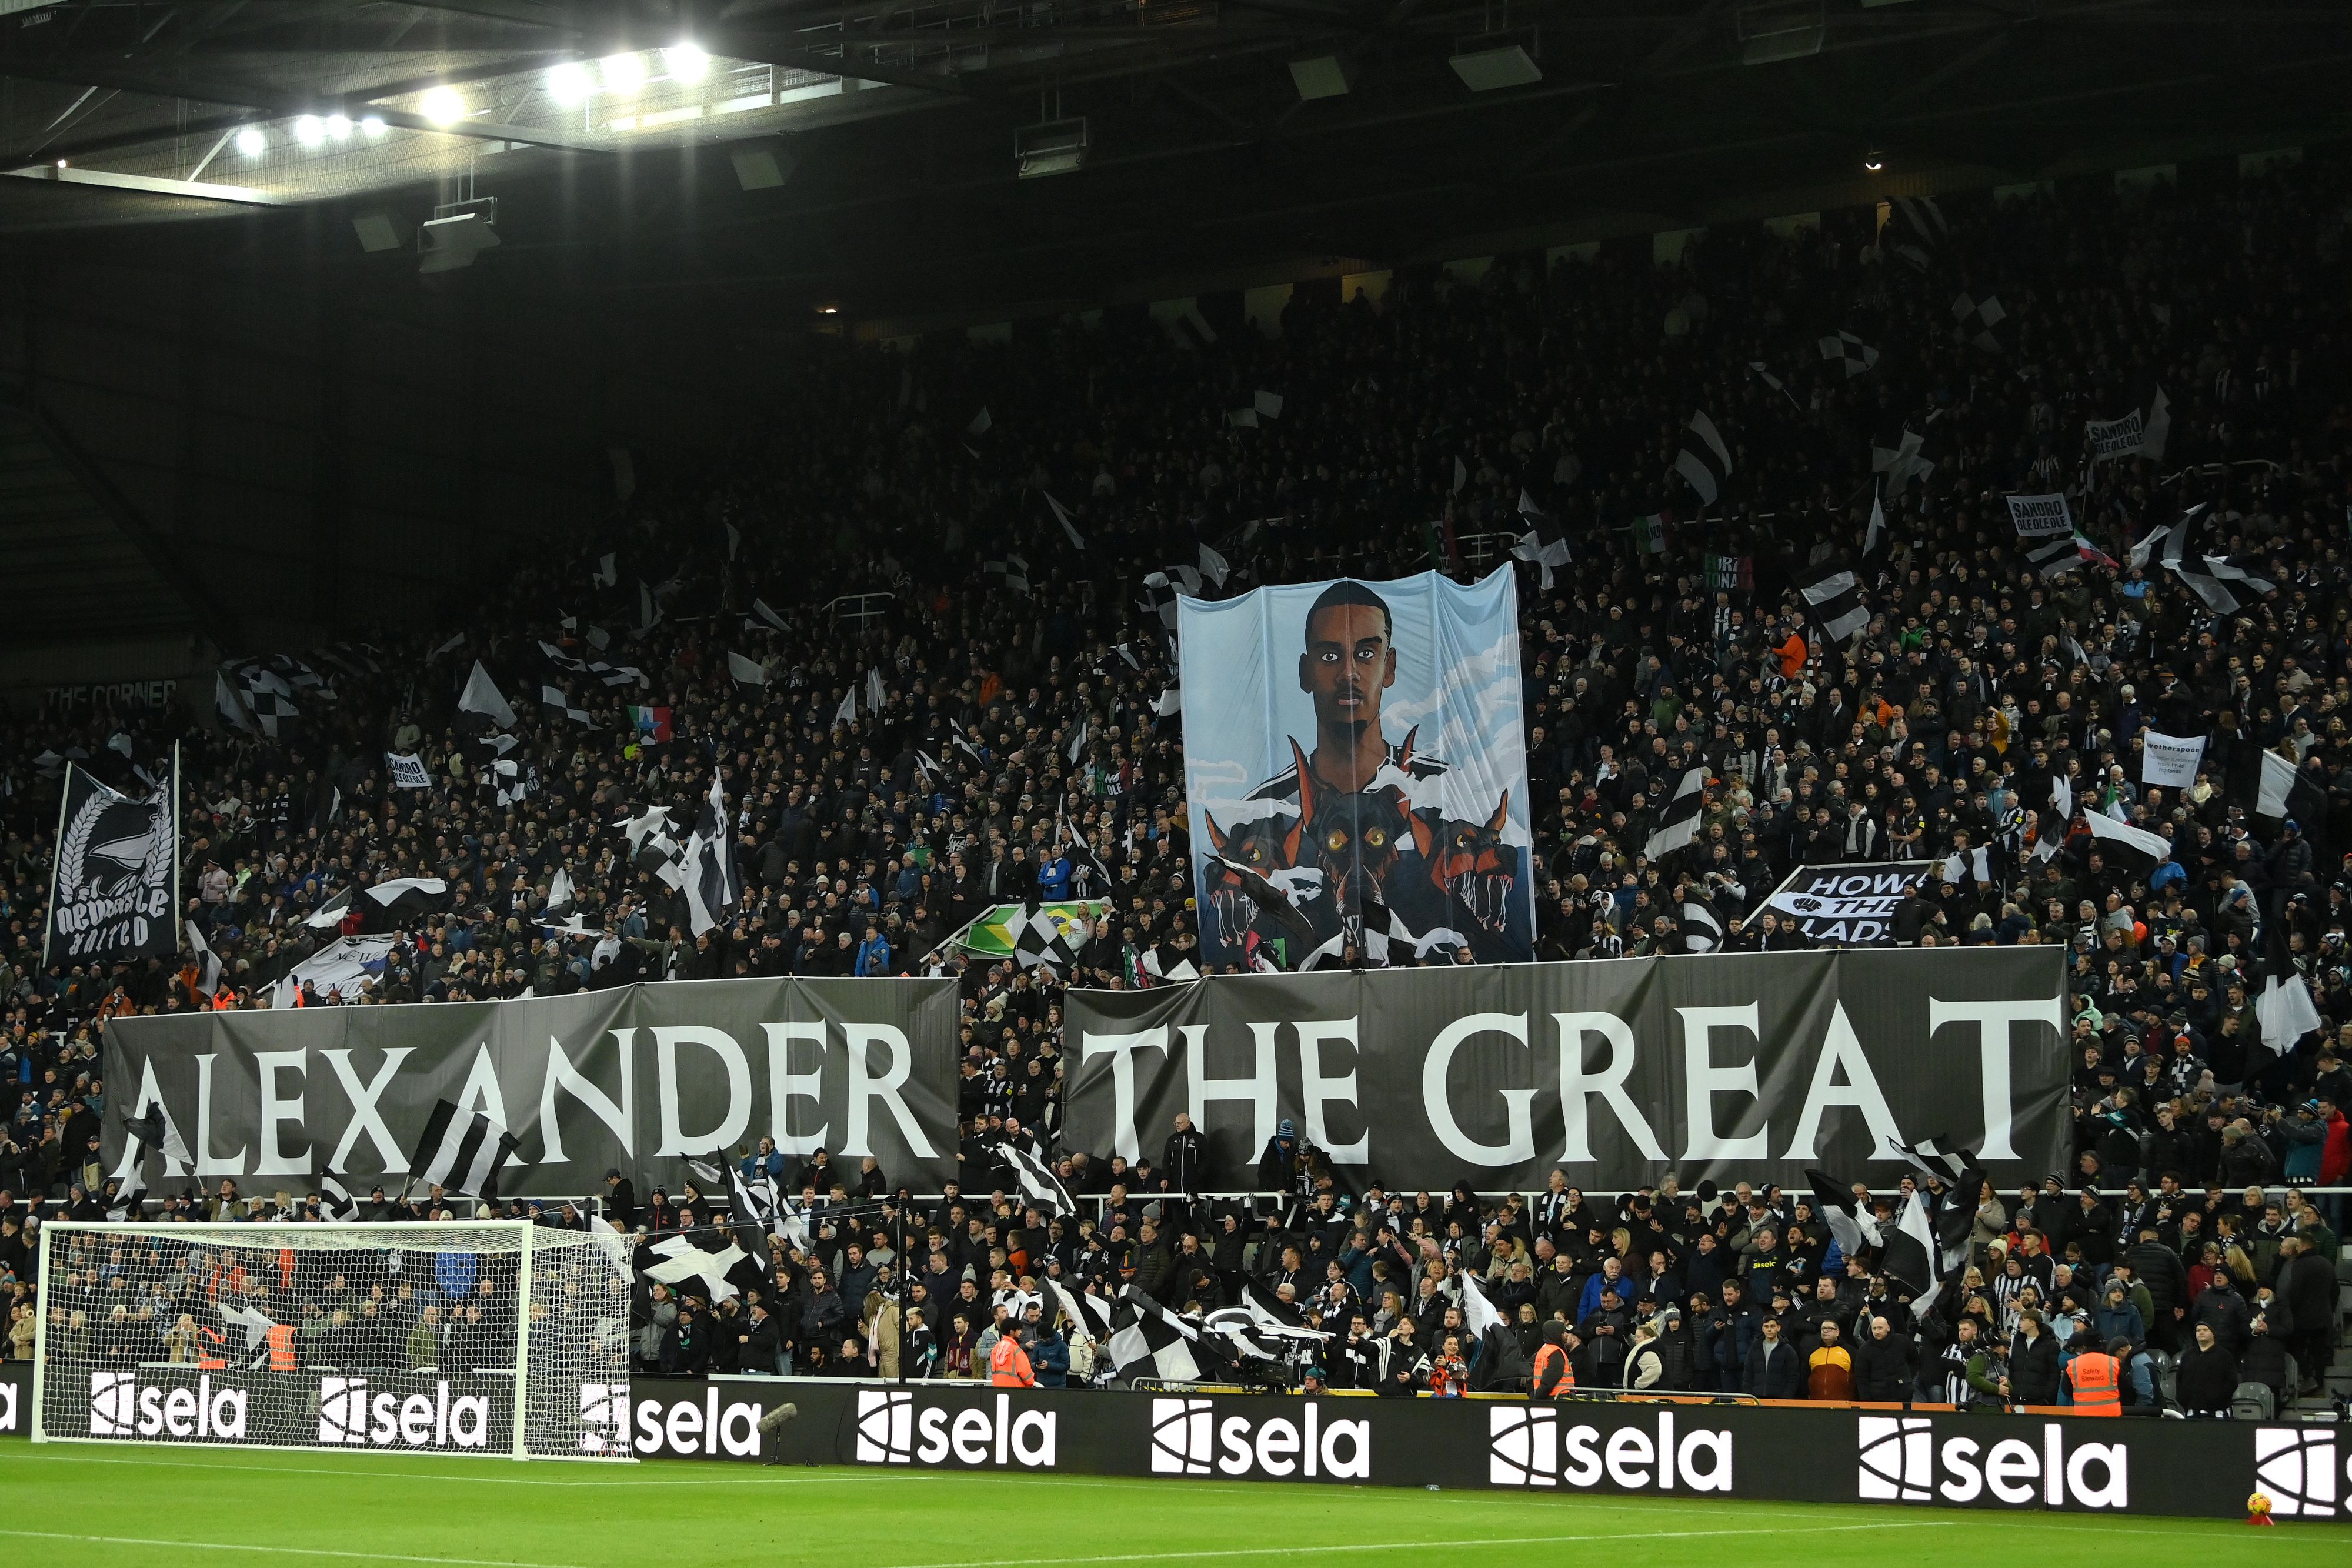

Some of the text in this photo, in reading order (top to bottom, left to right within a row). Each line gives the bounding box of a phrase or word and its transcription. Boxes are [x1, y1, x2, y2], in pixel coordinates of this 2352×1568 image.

[2091, 416, 2140, 442] SANDRO
[2111, 437, 2127, 450] OLE
[2126, 433, 2144, 447] OLE
[2012, 501, 2063, 518] SANDRO
[2017, 516, 2067, 530] OLE OLE OLE
[389, 758, 421, 775] SANDRO
[2147, 743, 2200, 753] wetherspoon
[1831, 899, 1900, 915] THE
[109, 1018, 940, 1178] ALEXANDER
[1082, 994, 2062, 1167] THE GREAT
[138, 1375, 247, 1438] sela
[370, 1380, 488, 1449] sela
[635, 1387, 762, 1456] sela
[918, 1394, 1056, 1466] sela
[1218, 1402, 1370, 1478] sela
[1564, 1411, 1732, 1491] sela
[1940, 1423, 2127, 1507] sela
